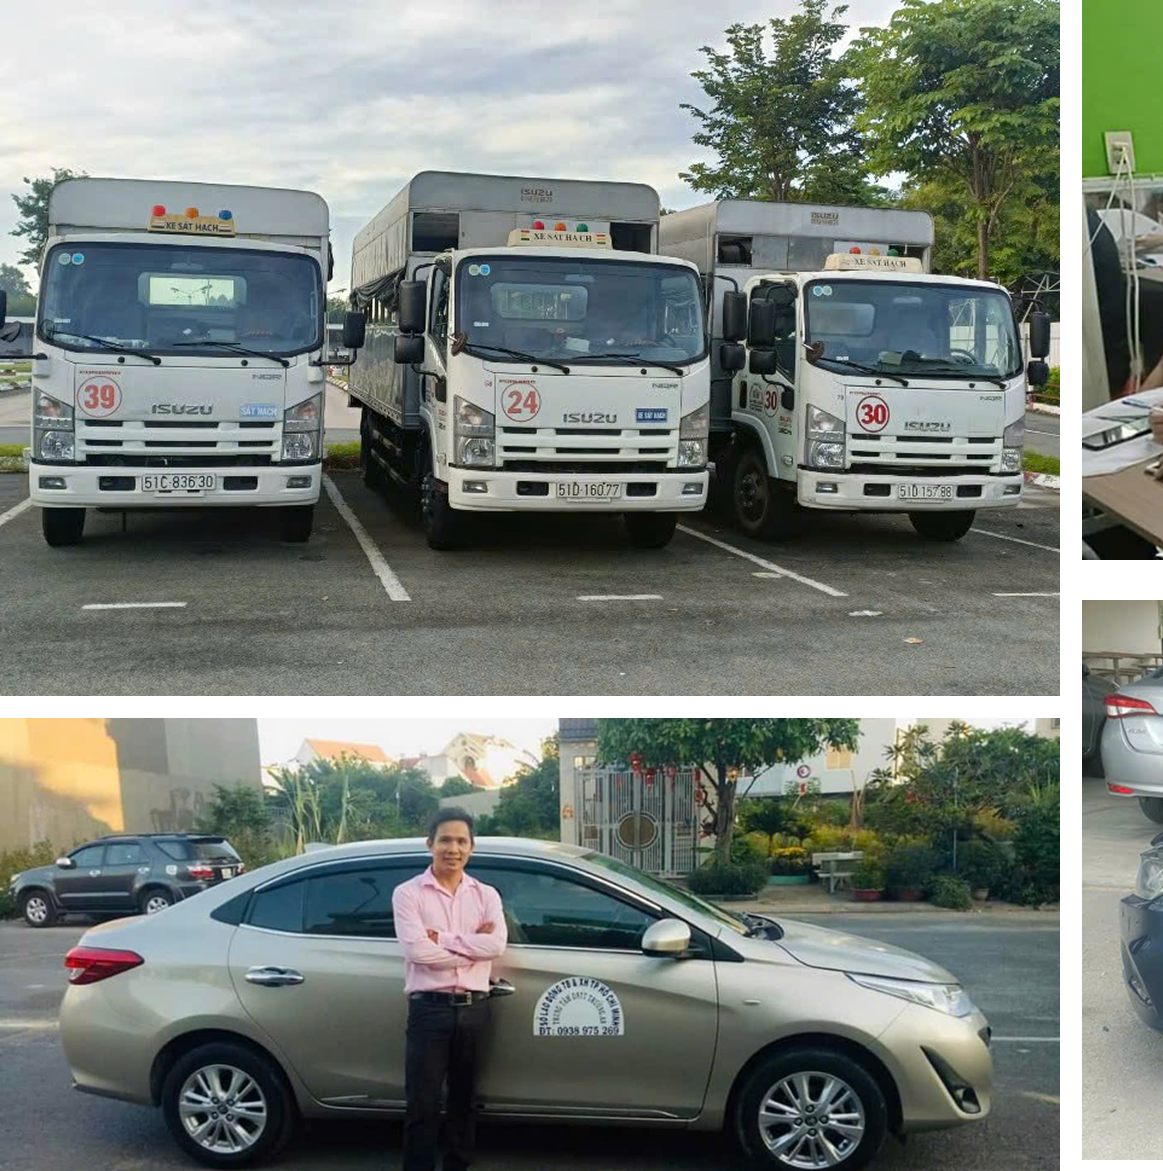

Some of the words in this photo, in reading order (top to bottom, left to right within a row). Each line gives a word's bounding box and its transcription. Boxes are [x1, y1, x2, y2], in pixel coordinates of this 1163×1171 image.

[166, 221, 176, 229] XE
[84, 385, 115, 409] 39
[507, 390, 538, 414] 24
[765, 391, 778, 411] 30
[151, 403, 214, 415] ISUZU
[861, 404, 887, 425] 30
[563, 412, 617, 424] ISUZU
[903, 421, 951, 432] ISUZU
[557, 1026, 580, 1035] 0938
[582, 1026, 599, 1035] 975
[602, 1026, 620, 1036] 269
